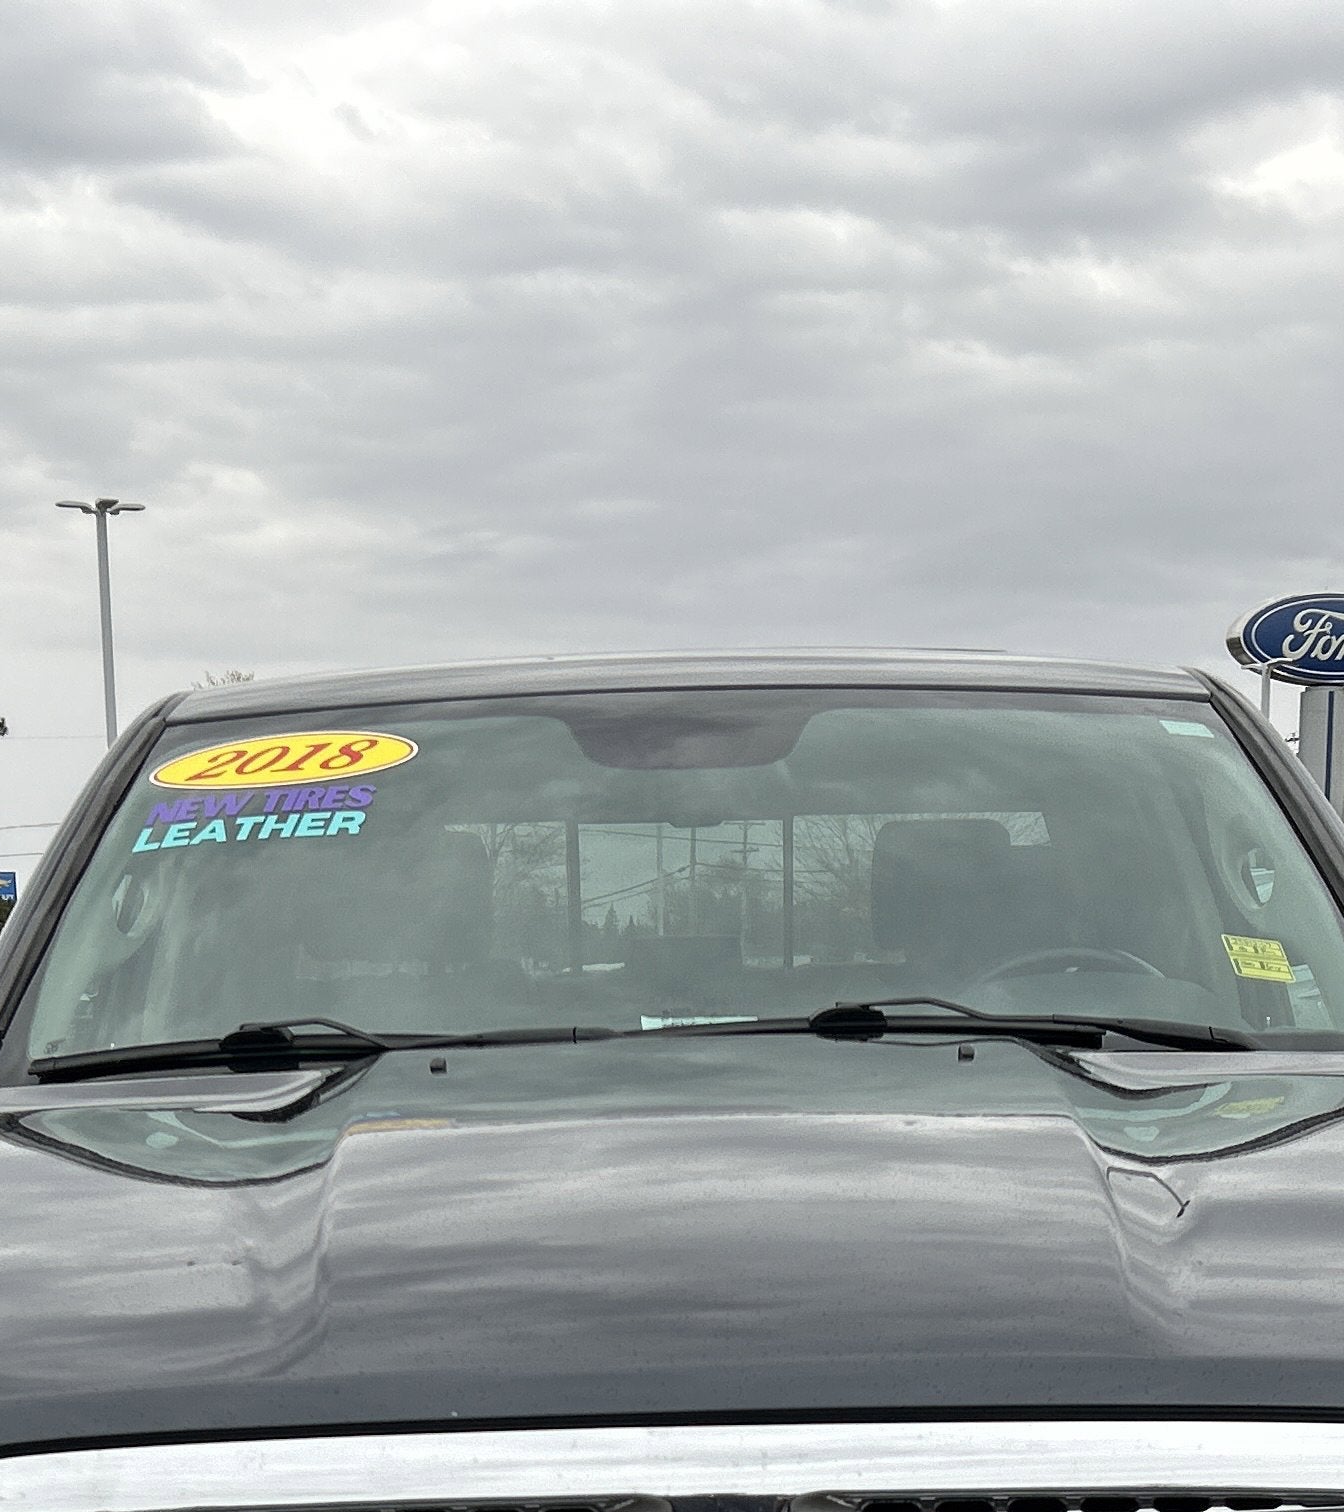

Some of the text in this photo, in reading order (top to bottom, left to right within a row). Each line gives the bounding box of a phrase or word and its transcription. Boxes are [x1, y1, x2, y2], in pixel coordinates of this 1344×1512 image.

[185, 738, 380, 782] 2018
[145, 783, 377, 826] NEW TIRES
[132, 811, 366, 853] LEATHER
